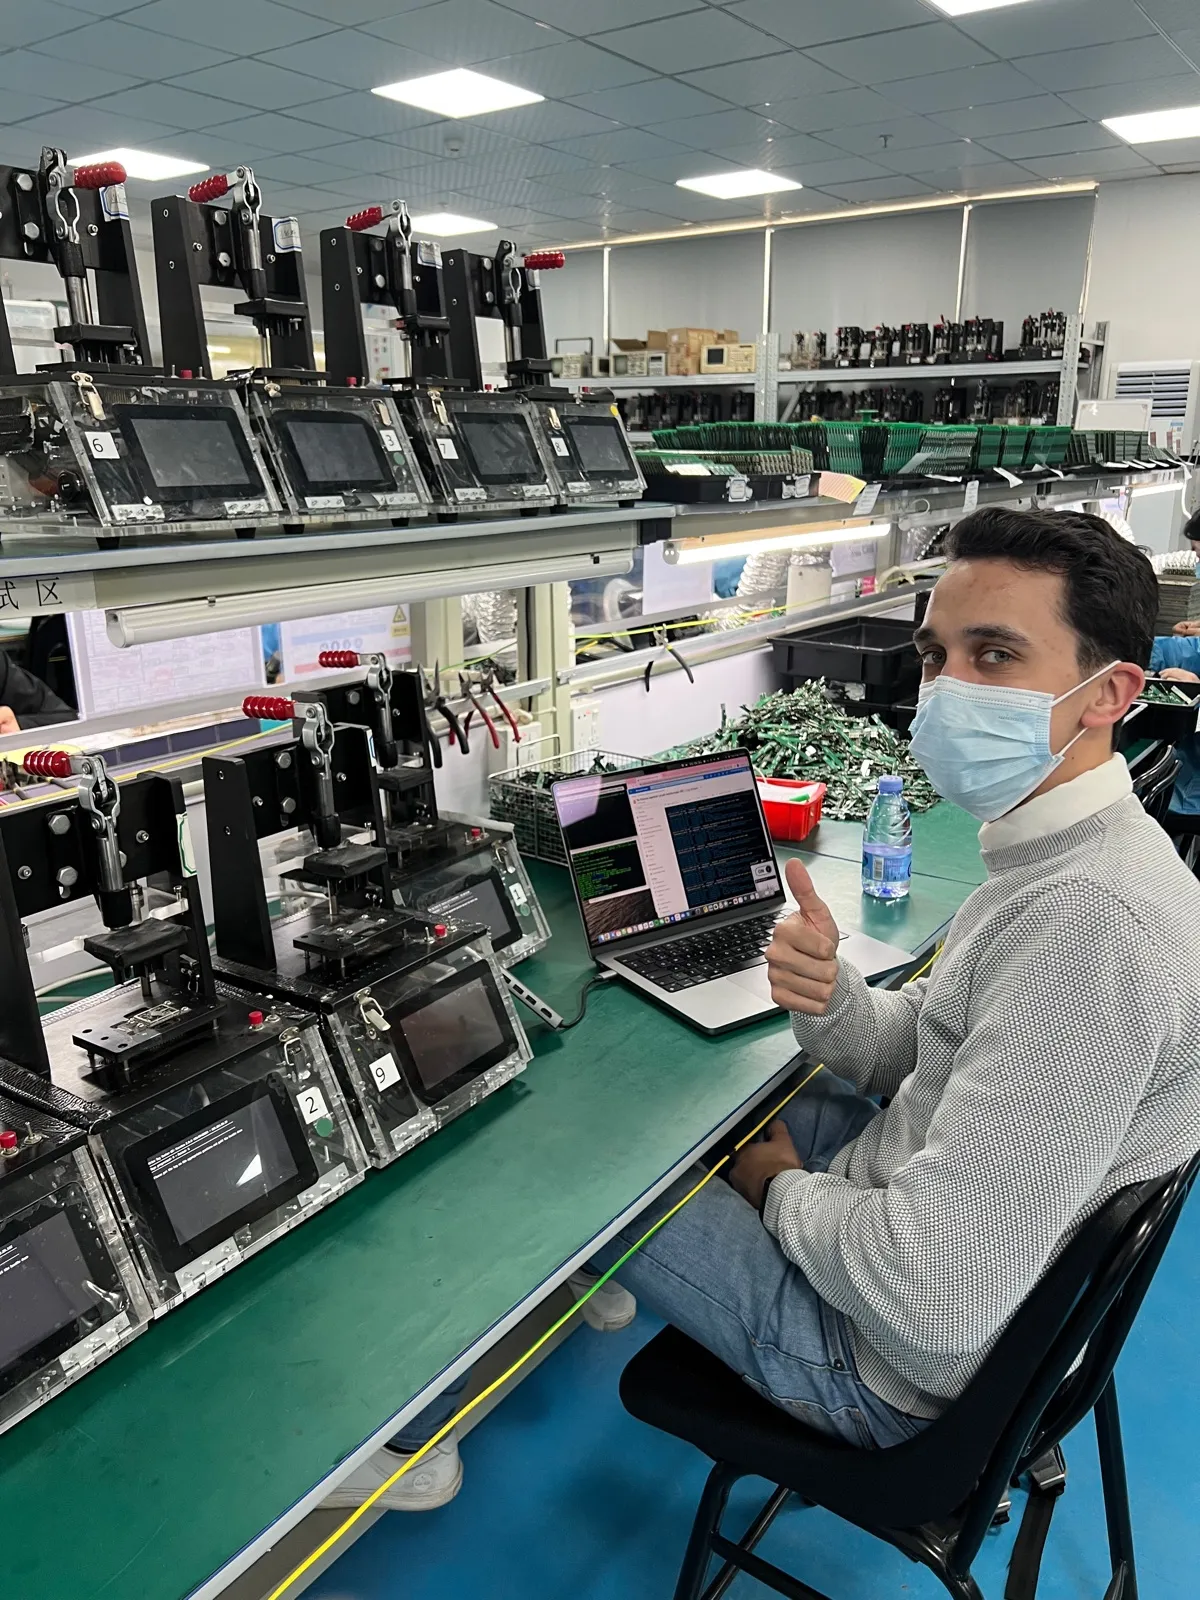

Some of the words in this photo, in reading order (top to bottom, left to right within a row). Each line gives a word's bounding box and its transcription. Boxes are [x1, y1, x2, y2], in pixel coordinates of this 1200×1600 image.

[92, 438, 104, 453] 6
[385, 434, 395, 447] 3
[554, 442, 562, 452] 8
[439, 443, 446, 454] 7
[513, 889, 521, 900] 1
[375, 1067, 386, 1084] 9
[305, 1096, 319, 1114] 2
